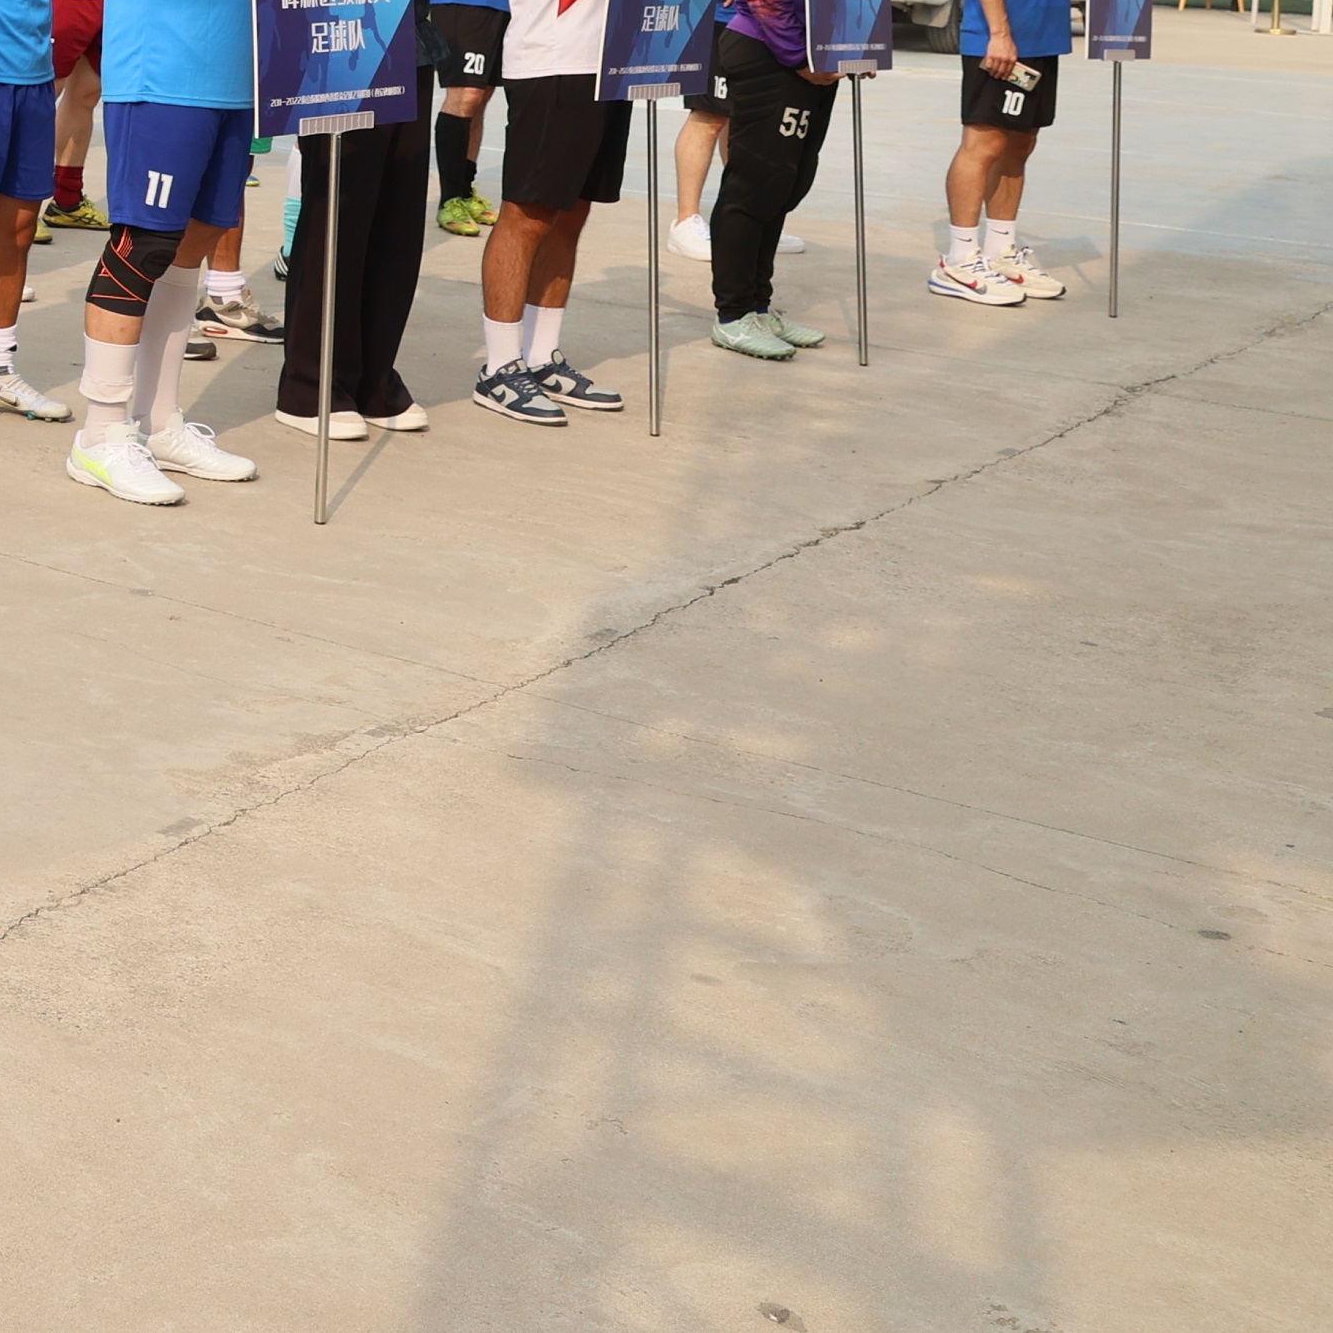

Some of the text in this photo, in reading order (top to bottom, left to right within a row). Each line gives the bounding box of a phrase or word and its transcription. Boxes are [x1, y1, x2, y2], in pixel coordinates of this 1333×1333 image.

[641, 5, 680, 33] 足球队
[311, 19, 366, 54] 足球队
[463, 52, 485, 75] 20
[714, 75, 728, 99] 16
[1002, 90, 1025, 116] 10
[779, 107, 812, 139] 55
[147, 170, 174, 209] 11
